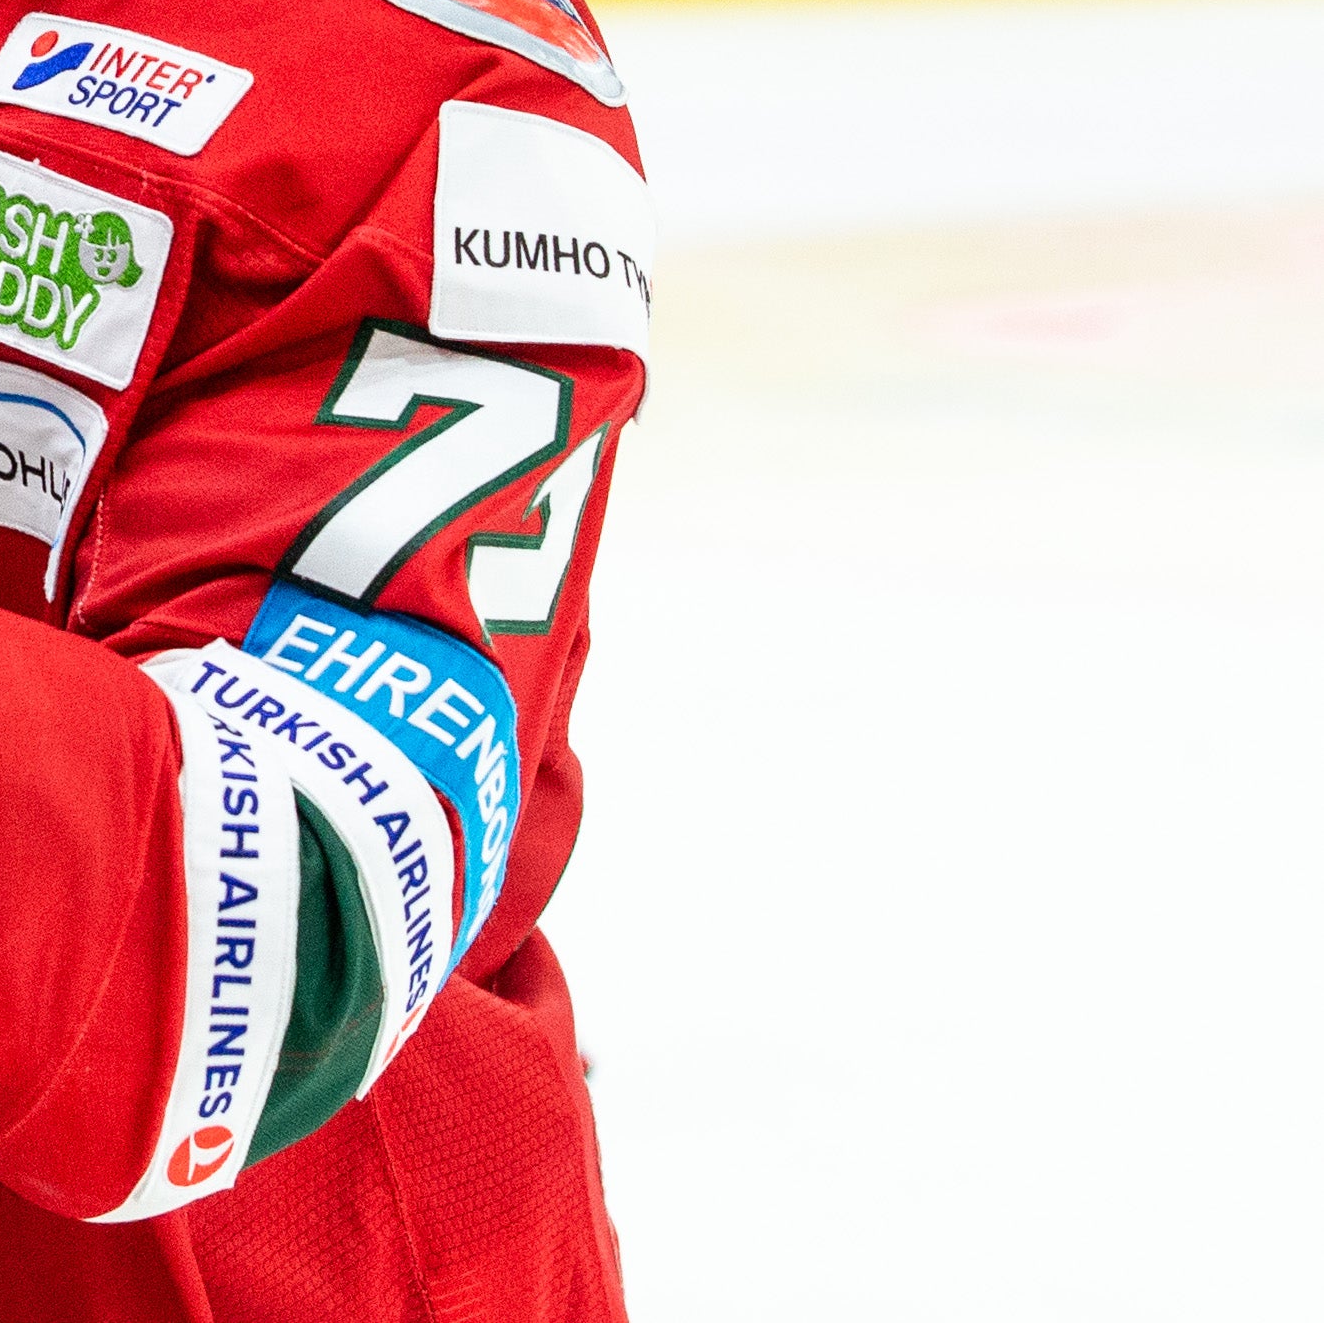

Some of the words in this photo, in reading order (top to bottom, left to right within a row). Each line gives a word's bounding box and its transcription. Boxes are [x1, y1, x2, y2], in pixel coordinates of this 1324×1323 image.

[68, 75, 182, 127] SPORT
[89, 42, 204, 100] INTER
[455, 227, 610, 279] KUMHO
[190, 661, 389, 806] TURKISH
[373, 810, 434, 1013] AIRLINES
[207, 712, 260, 860] RKISH
[199, 871, 259, 1119] AIRLINES
